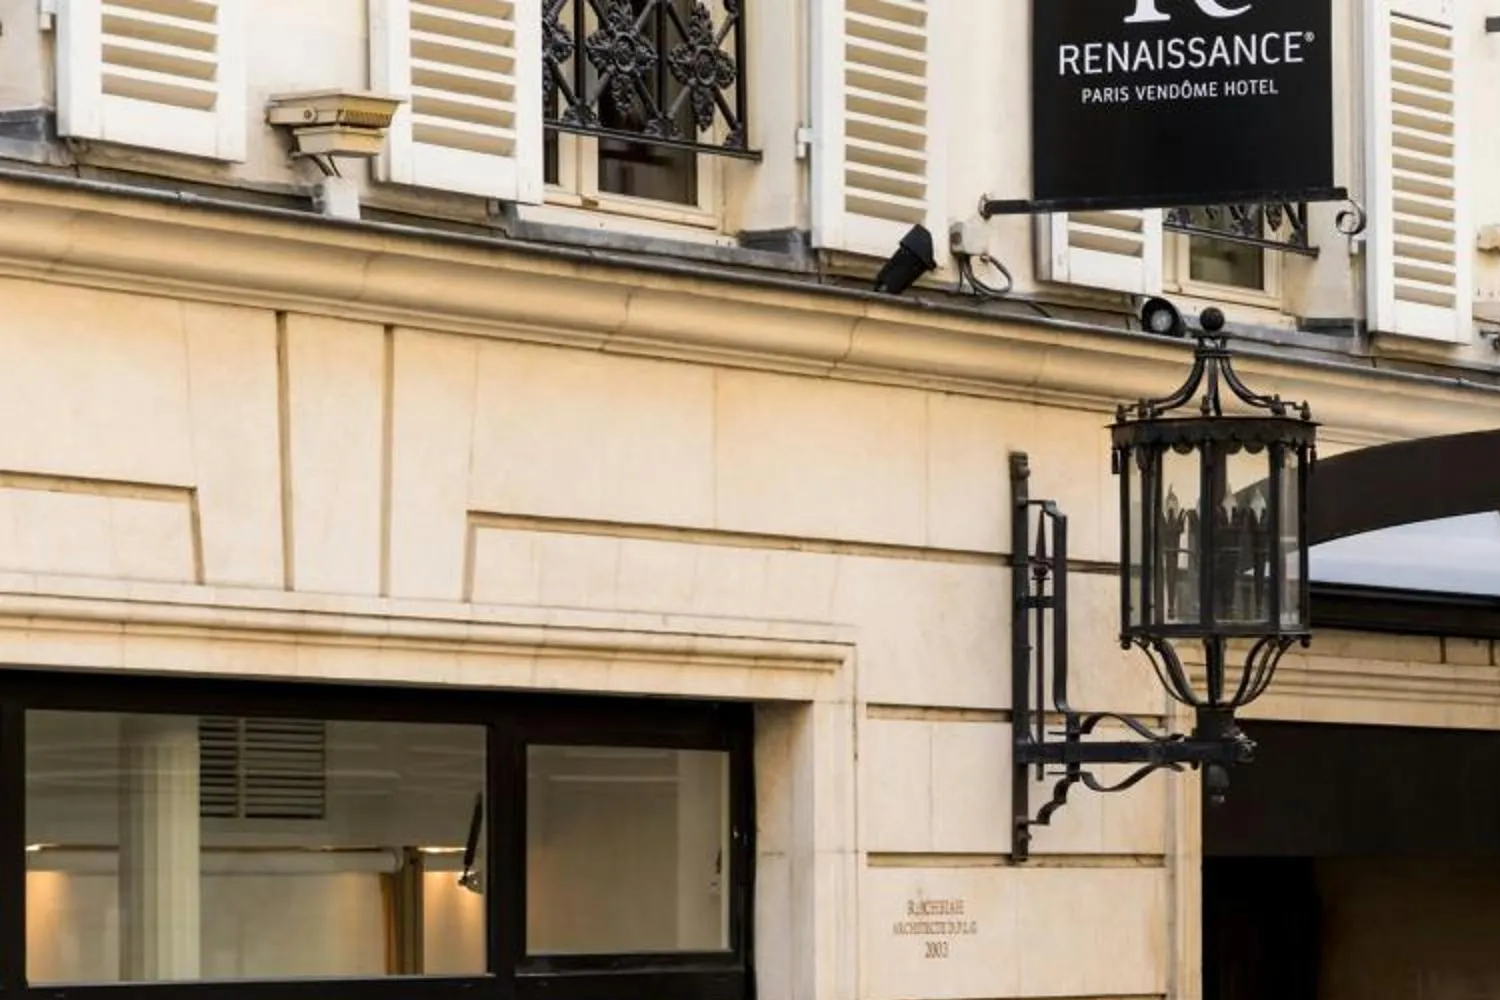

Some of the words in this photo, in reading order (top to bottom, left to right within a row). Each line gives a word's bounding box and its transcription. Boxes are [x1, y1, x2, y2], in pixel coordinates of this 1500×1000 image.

[1081, 86, 1129, 103] PARIS
[1135, 80, 1218, 101] VENDÔME
[1224, 79, 1279, 96] HOTEL
